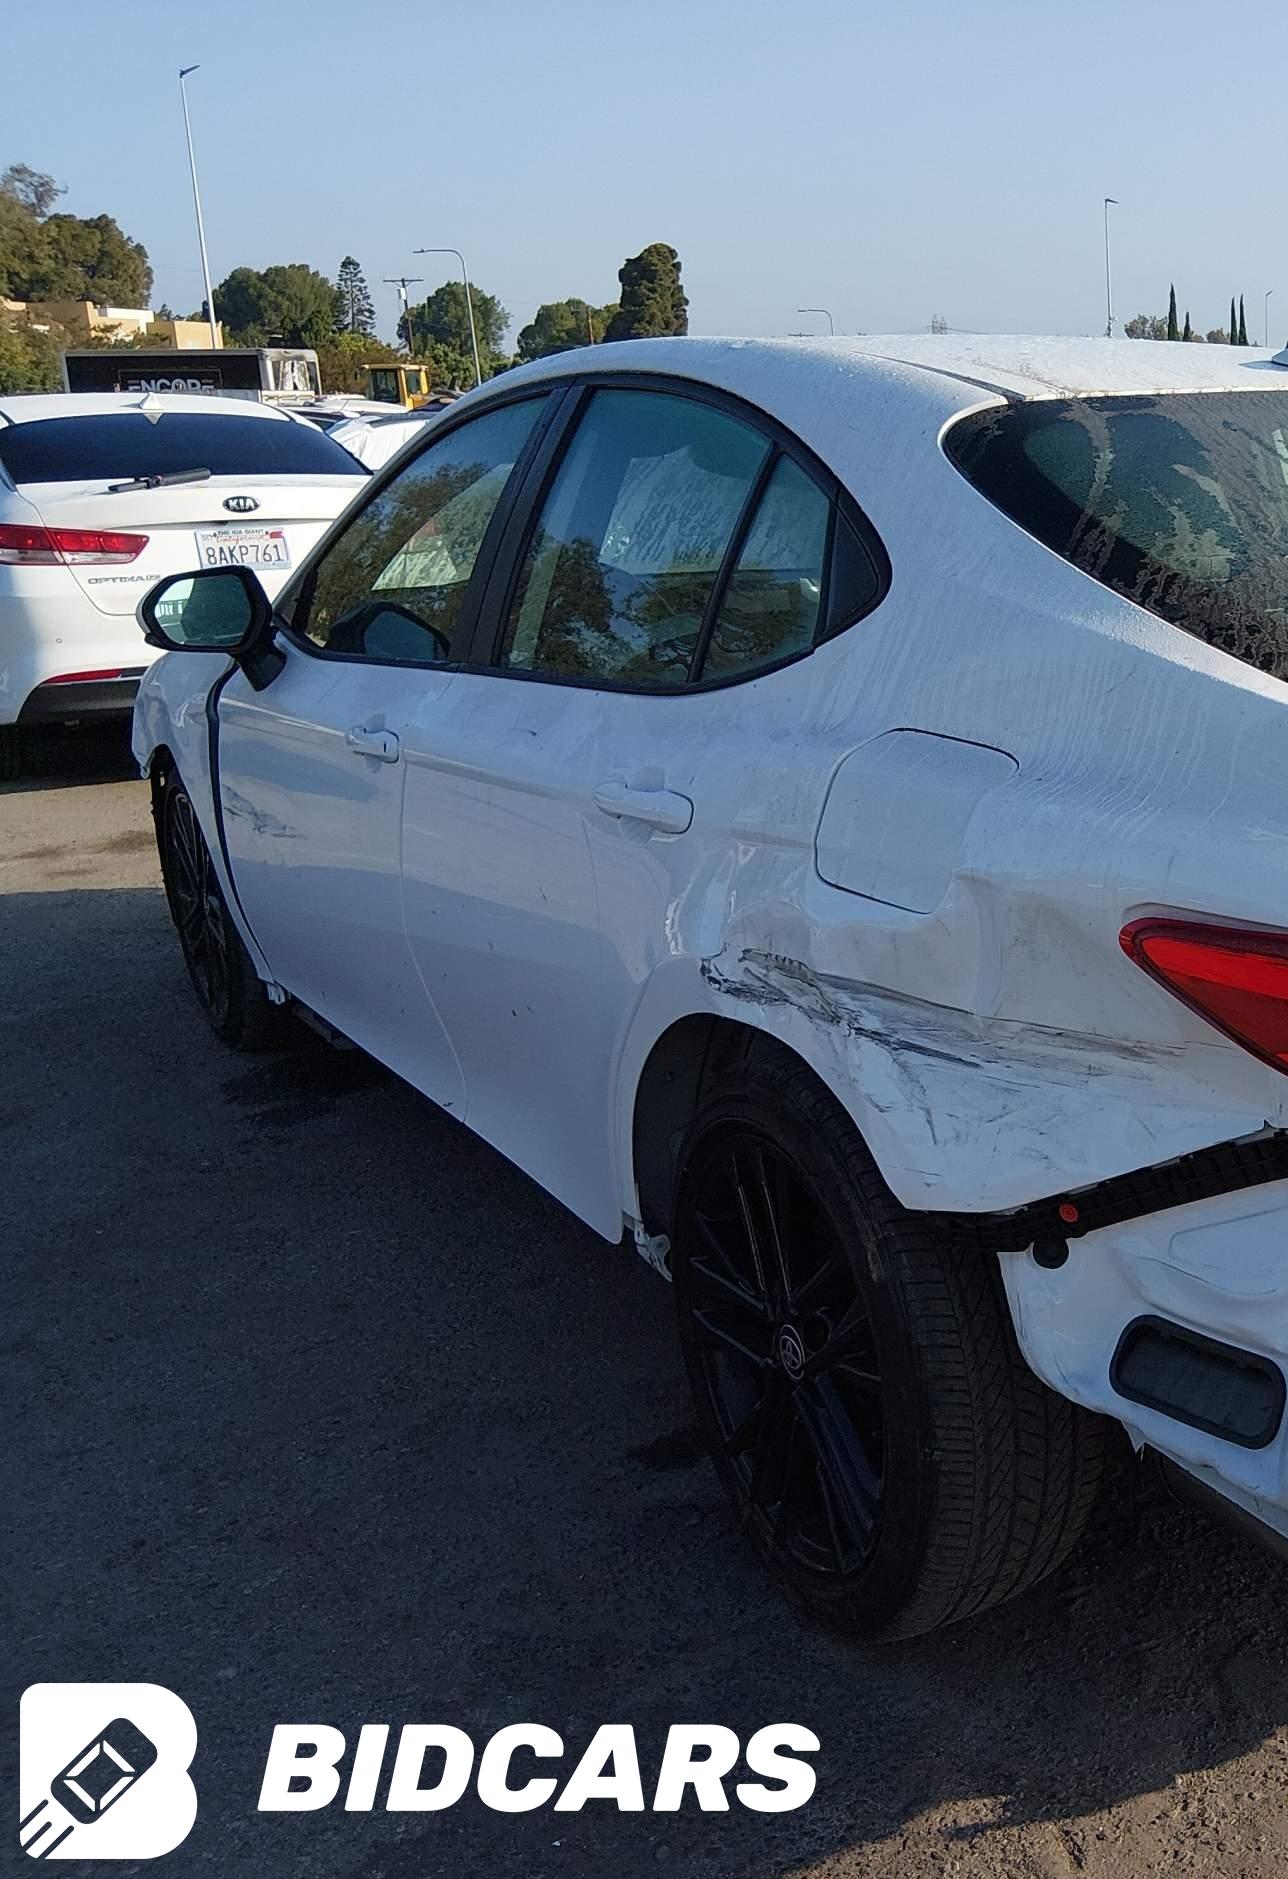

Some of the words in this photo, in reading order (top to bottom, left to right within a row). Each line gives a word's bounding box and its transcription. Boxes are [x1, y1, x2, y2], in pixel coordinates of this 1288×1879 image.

[228, 498, 256, 510] KIA
[206, 544, 285, 565] 8AKP761
[87, 575, 145, 585] OPTIMA
